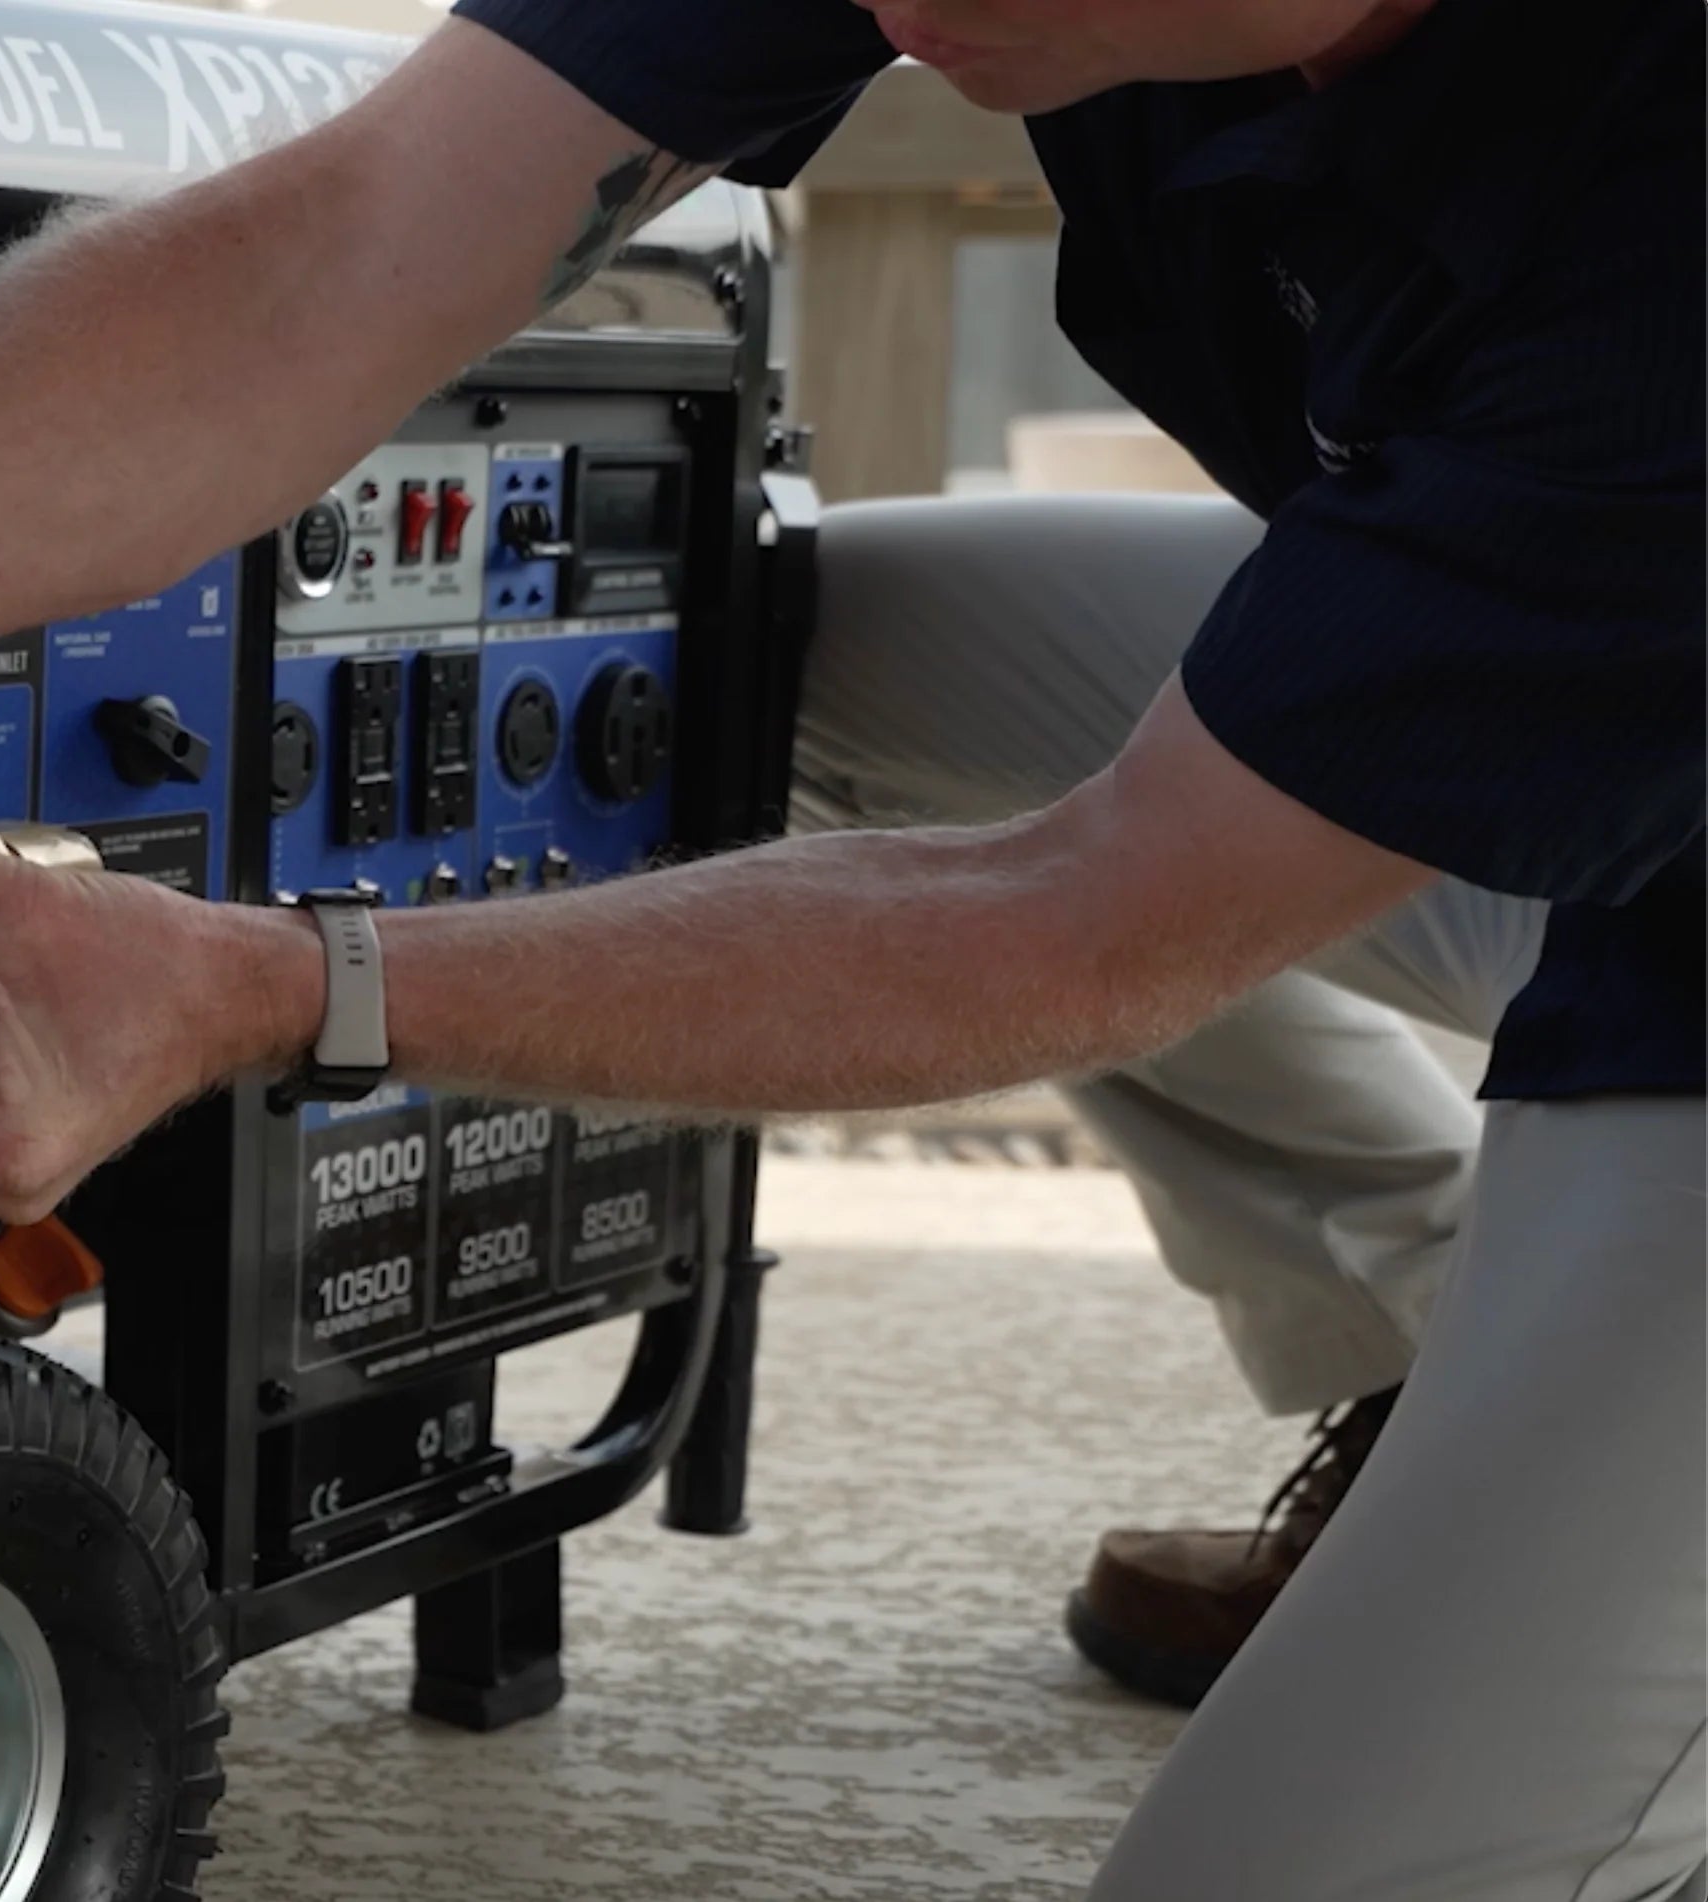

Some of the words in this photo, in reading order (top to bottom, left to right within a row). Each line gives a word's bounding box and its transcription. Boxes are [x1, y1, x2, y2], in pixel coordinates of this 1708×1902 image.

[445, 1106, 551, 1169] 12000
[311, 1134, 426, 1203] 13000
[450, 1167, 490, 1195] PEAK
[493, 1152, 545, 1184] WATTS
[316, 1200, 360, 1230] PEAK
[362, 1185, 417, 1218] WATTS
[582, 1190, 650, 1240] 8500
[459, 1223, 530, 1275] 9500
[319, 1256, 412, 1317] 10500
[314, 1307, 370, 1340] RUNNING
[371, 1295, 412, 1323] WATTS
